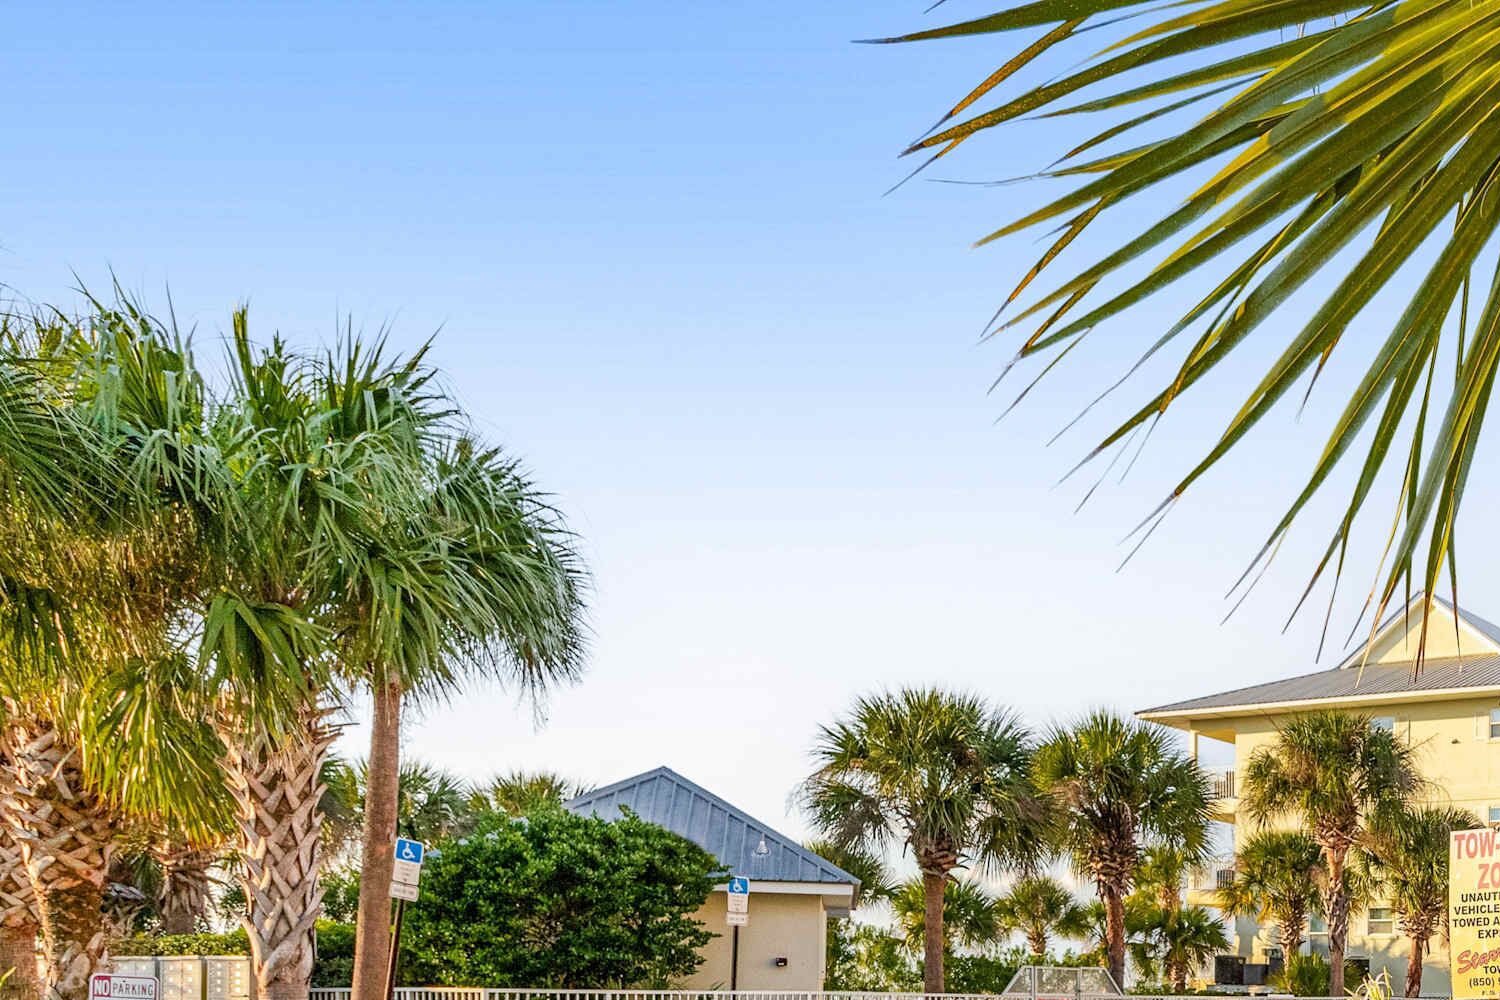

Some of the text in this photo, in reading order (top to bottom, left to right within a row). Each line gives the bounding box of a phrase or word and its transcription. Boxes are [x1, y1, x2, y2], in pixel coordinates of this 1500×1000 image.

[1453, 916, 1490, 928] TOWED
[95, 979, 153, 996] NO PARKING
[1469, 977, 1495, 988] (850)
